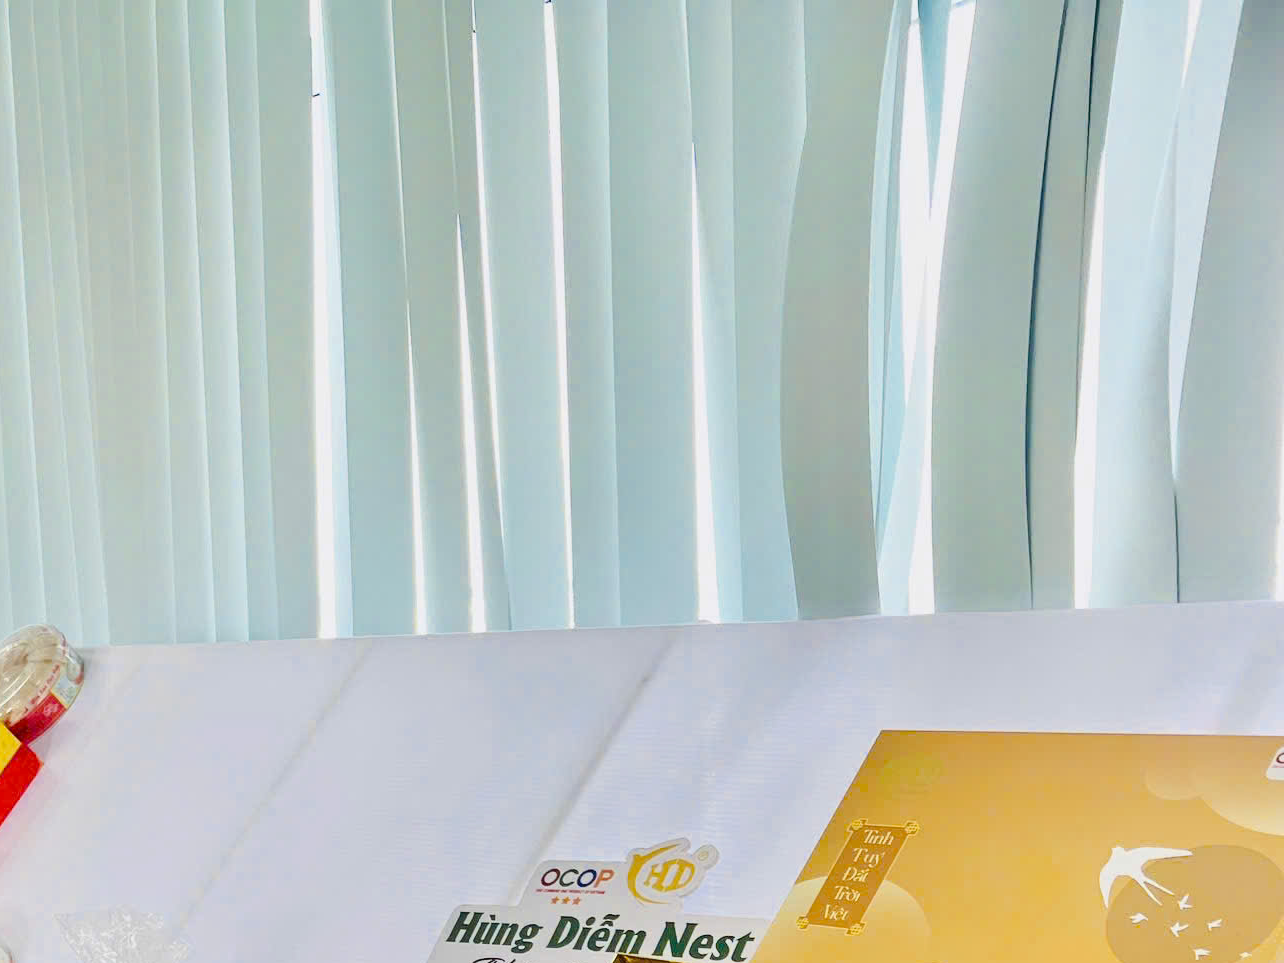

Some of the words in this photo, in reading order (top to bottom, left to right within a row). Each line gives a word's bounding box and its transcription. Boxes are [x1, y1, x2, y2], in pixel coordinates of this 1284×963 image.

[863, 829, 894, 845] Tinh
[541, 868, 614, 888] OCOP
[446, 911, 543, 954] Hùng
[546, 914, 647, 955] Diễm
[651, 921, 756, 963] Nest
